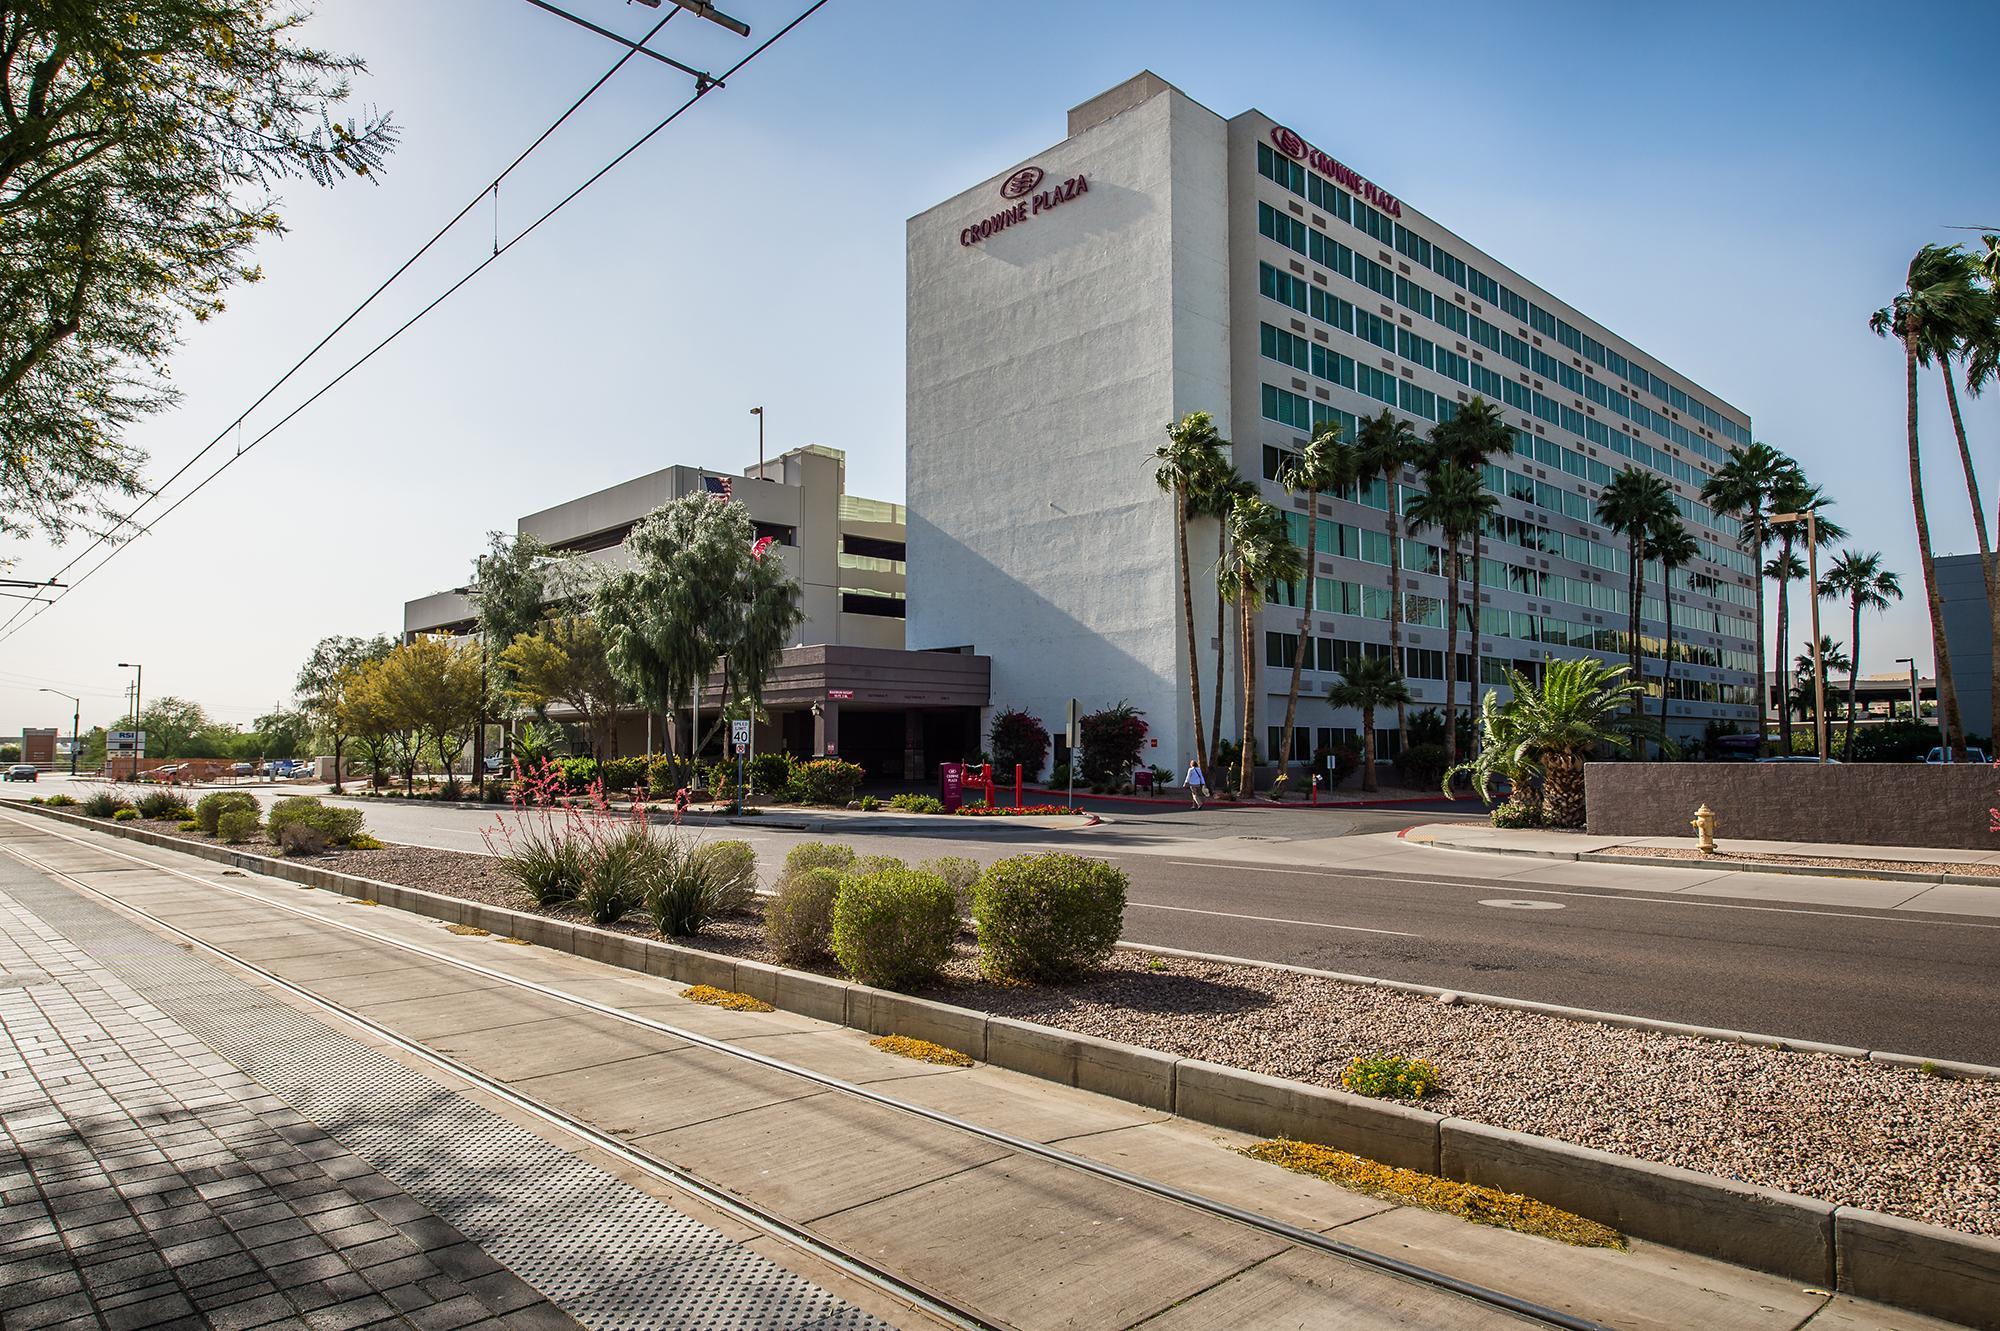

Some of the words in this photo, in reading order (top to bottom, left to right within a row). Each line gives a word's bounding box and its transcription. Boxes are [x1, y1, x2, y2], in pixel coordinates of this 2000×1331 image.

[960, 201, 1027, 247] CROWNE
[1032, 174, 1089, 216] PLAZA
[1310, 150, 1363, 195] CROWNE
[1364, 181, 1402, 218] PLAZA
[734, 731, 748, 742] 40
